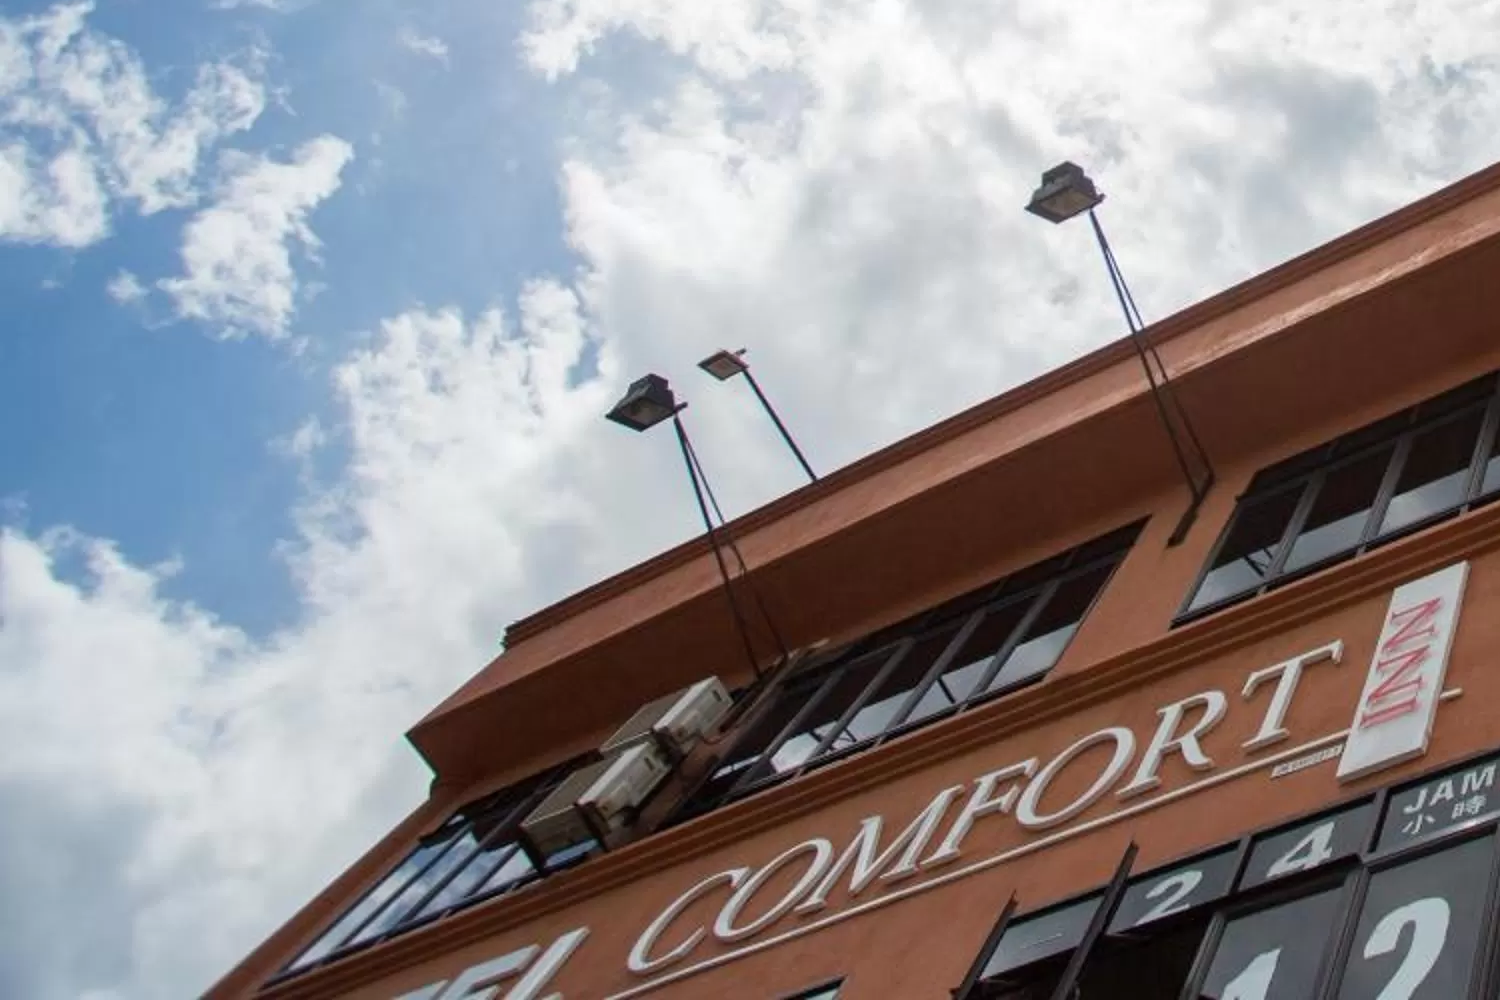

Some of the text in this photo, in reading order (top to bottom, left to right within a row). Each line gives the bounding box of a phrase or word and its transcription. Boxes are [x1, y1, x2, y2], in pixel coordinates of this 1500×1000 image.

[626, 639, 1343, 974] COMFORT
[1360, 597, 1443, 730] INN
[1403, 763, 1498, 814] JAM
